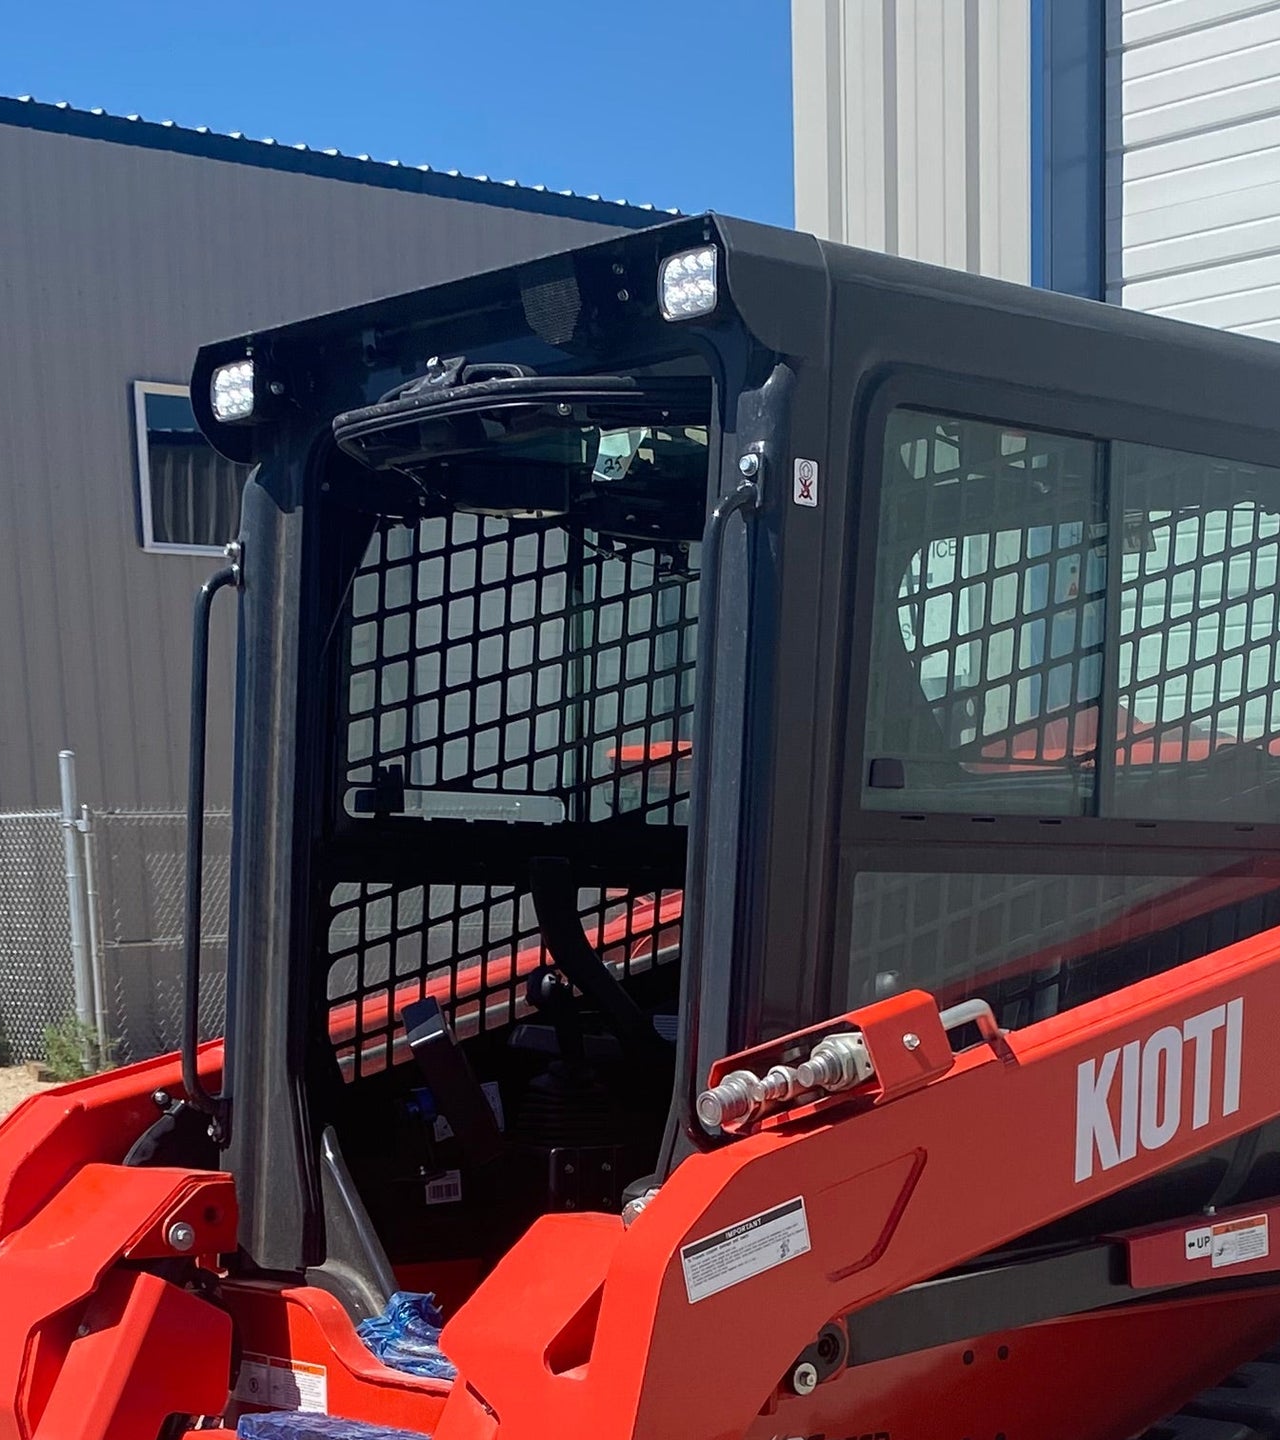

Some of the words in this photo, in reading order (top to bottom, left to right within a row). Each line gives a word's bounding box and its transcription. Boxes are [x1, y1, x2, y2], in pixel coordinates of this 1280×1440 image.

[1074, 996, 1244, 1184] KIOTI
[724, 1217, 763, 1240] IMPORTANT
[1196, 1235, 1211, 1249] UP
